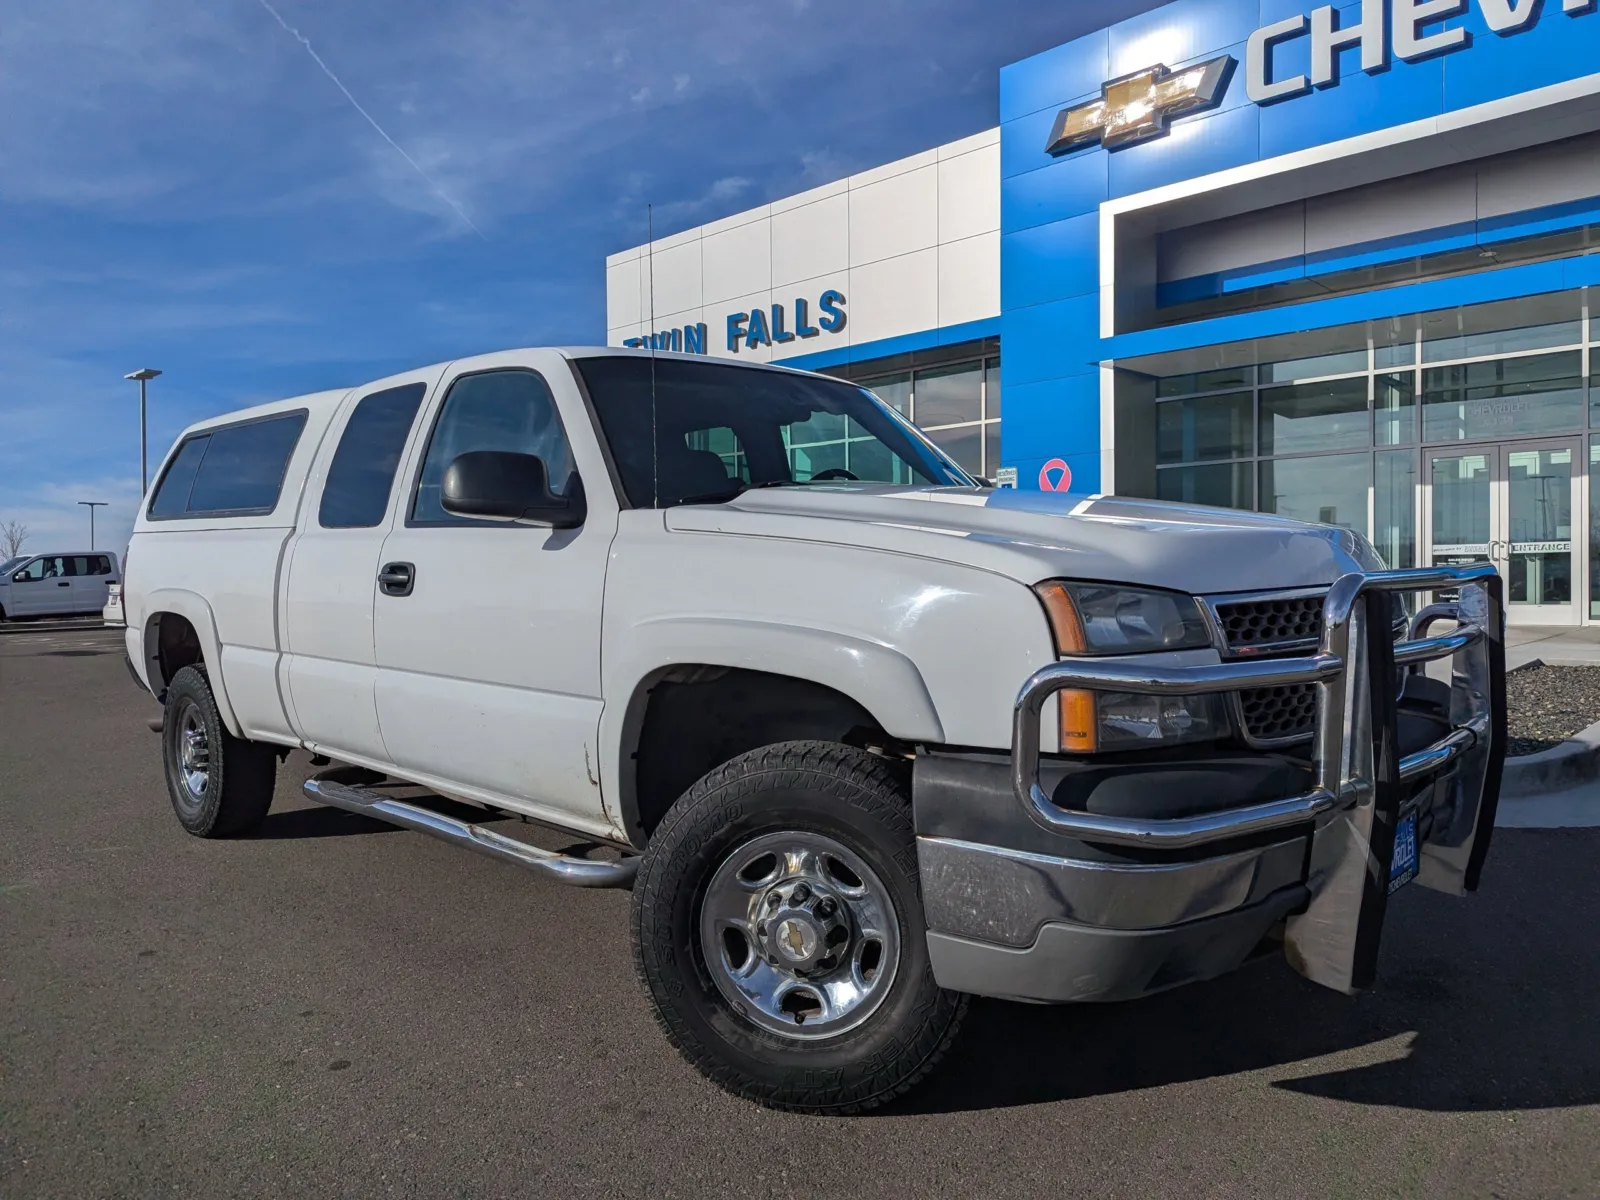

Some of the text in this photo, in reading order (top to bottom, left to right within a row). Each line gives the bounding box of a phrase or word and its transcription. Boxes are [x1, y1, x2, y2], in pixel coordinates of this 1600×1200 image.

[1246, 0, 1600, 103] CHE
[623, 289, 847, 356] WIN FALLS
[1513, 543, 1570, 552] ENTRANCE
